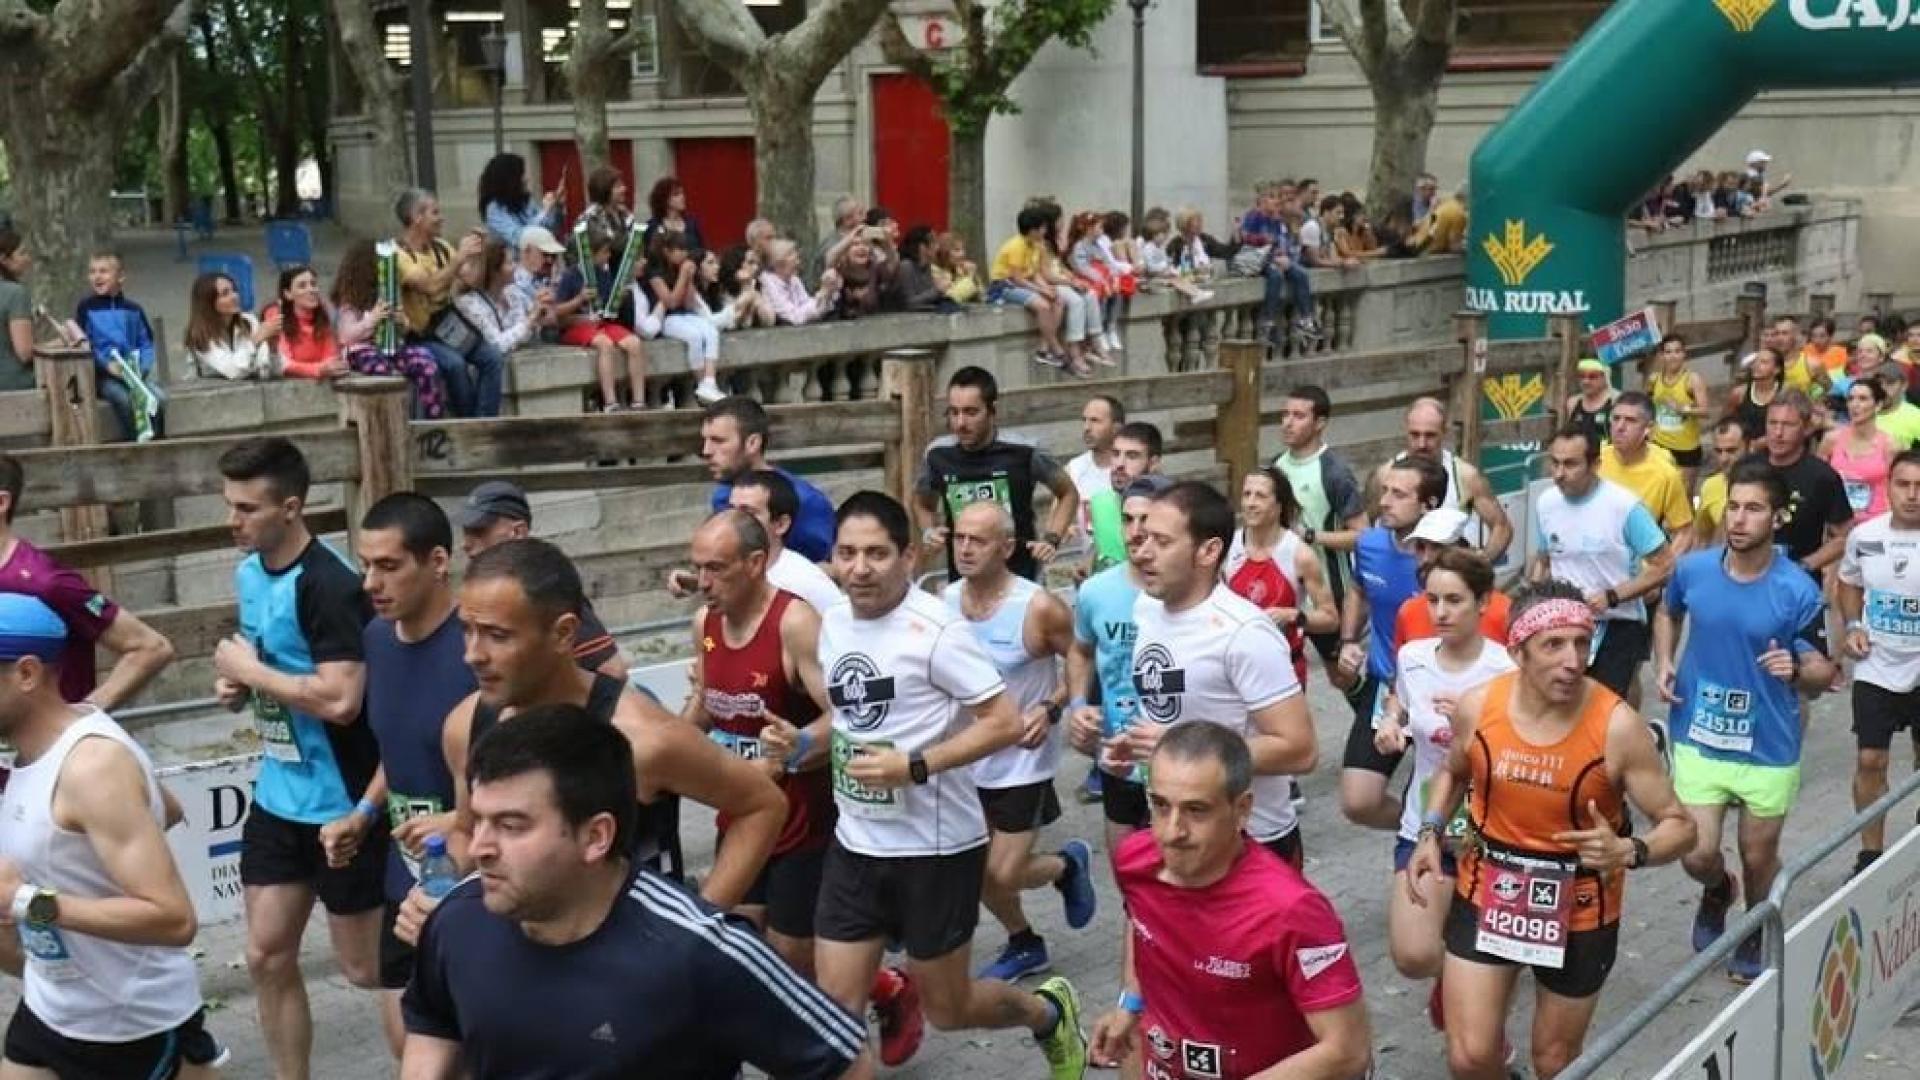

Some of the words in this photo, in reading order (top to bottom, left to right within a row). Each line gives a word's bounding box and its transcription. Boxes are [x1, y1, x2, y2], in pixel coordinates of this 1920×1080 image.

[926, 23, 944, 49] C
[1504, 289, 1591, 314] RURAL
[1694, 708, 1750, 734] 21510
[207, 781, 257, 832] D
[1485, 908, 1561, 942] 42096
